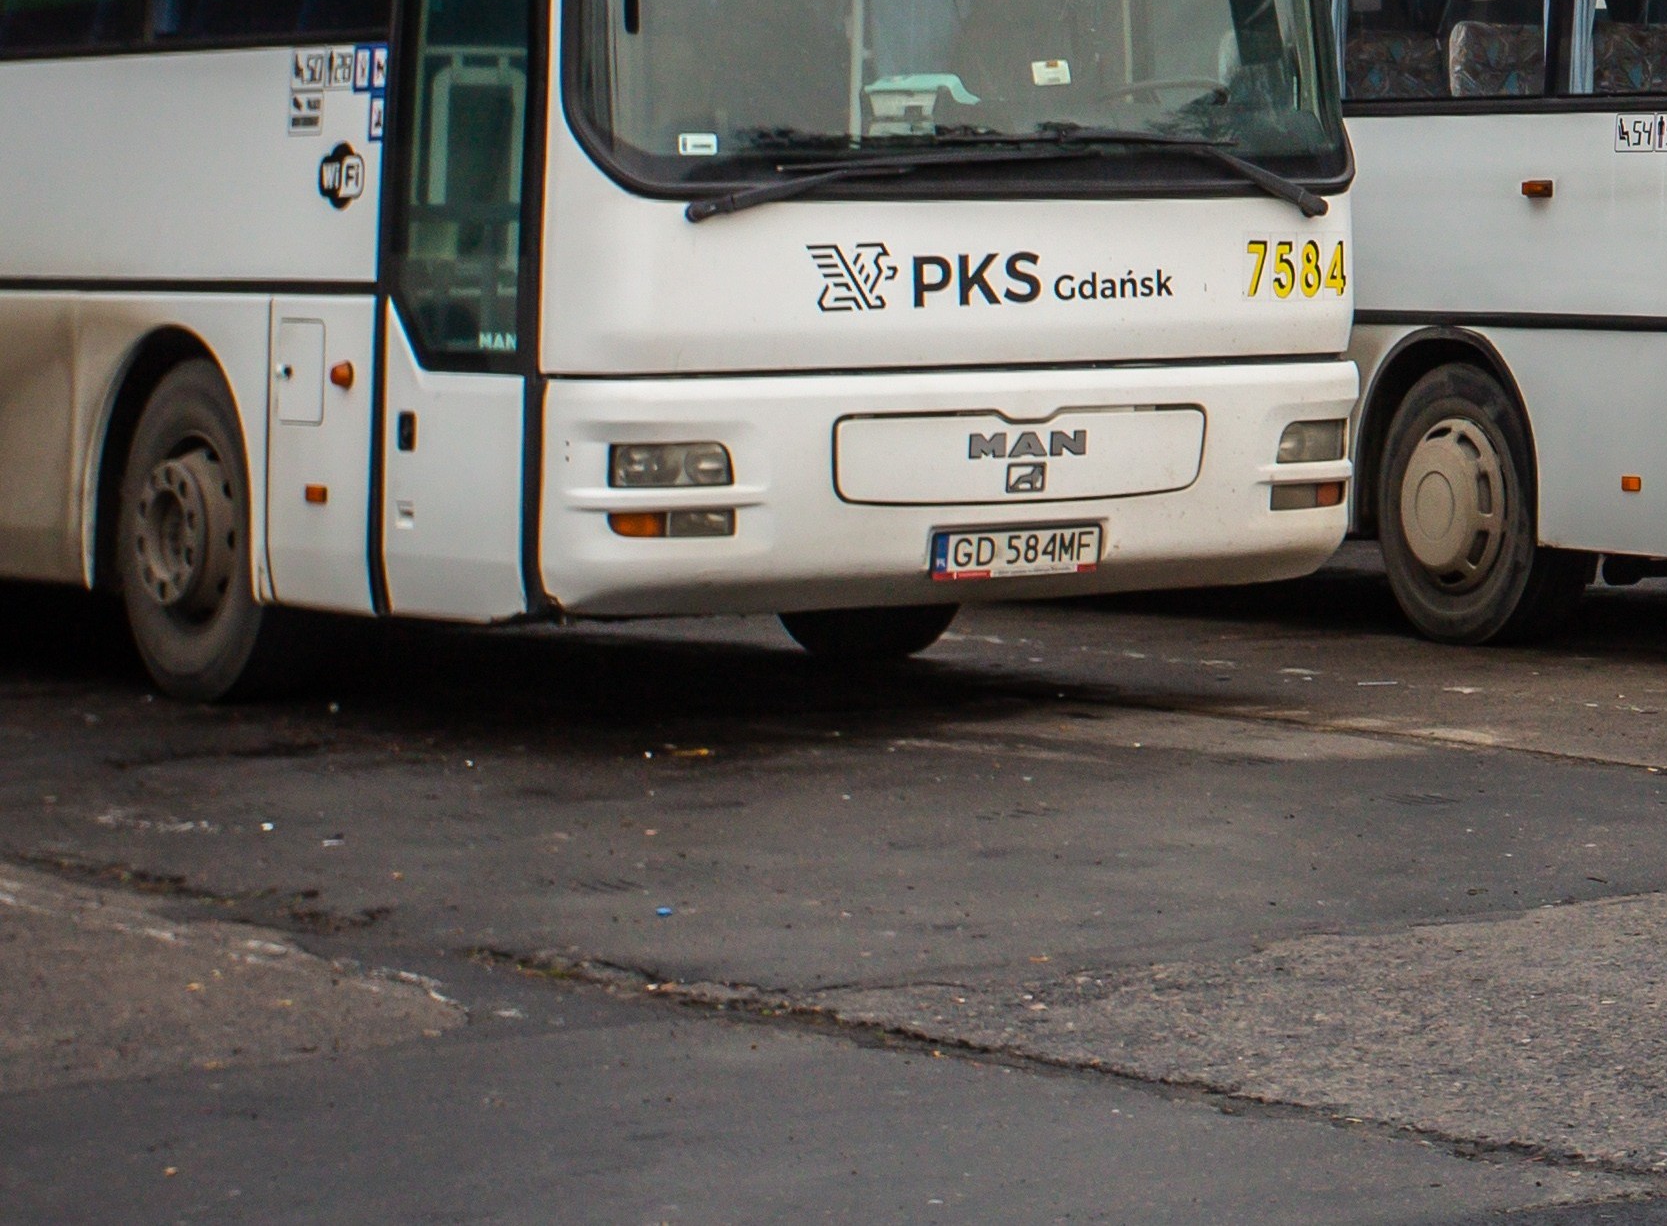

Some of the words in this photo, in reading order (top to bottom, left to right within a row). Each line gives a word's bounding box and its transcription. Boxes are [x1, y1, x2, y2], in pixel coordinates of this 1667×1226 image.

[1632, 119, 1653, 147] 54
[912, 251, 1042, 309] PKS
[1053, 269, 1174, 301] Gdańsk
[1246, 238, 1347, 299] 7584
[478, 331, 517, 351] MAN
[968, 429, 1087, 459] MAN
[953, 536, 996, 567] GD
[1005, 530, 1095, 565] 584MF
